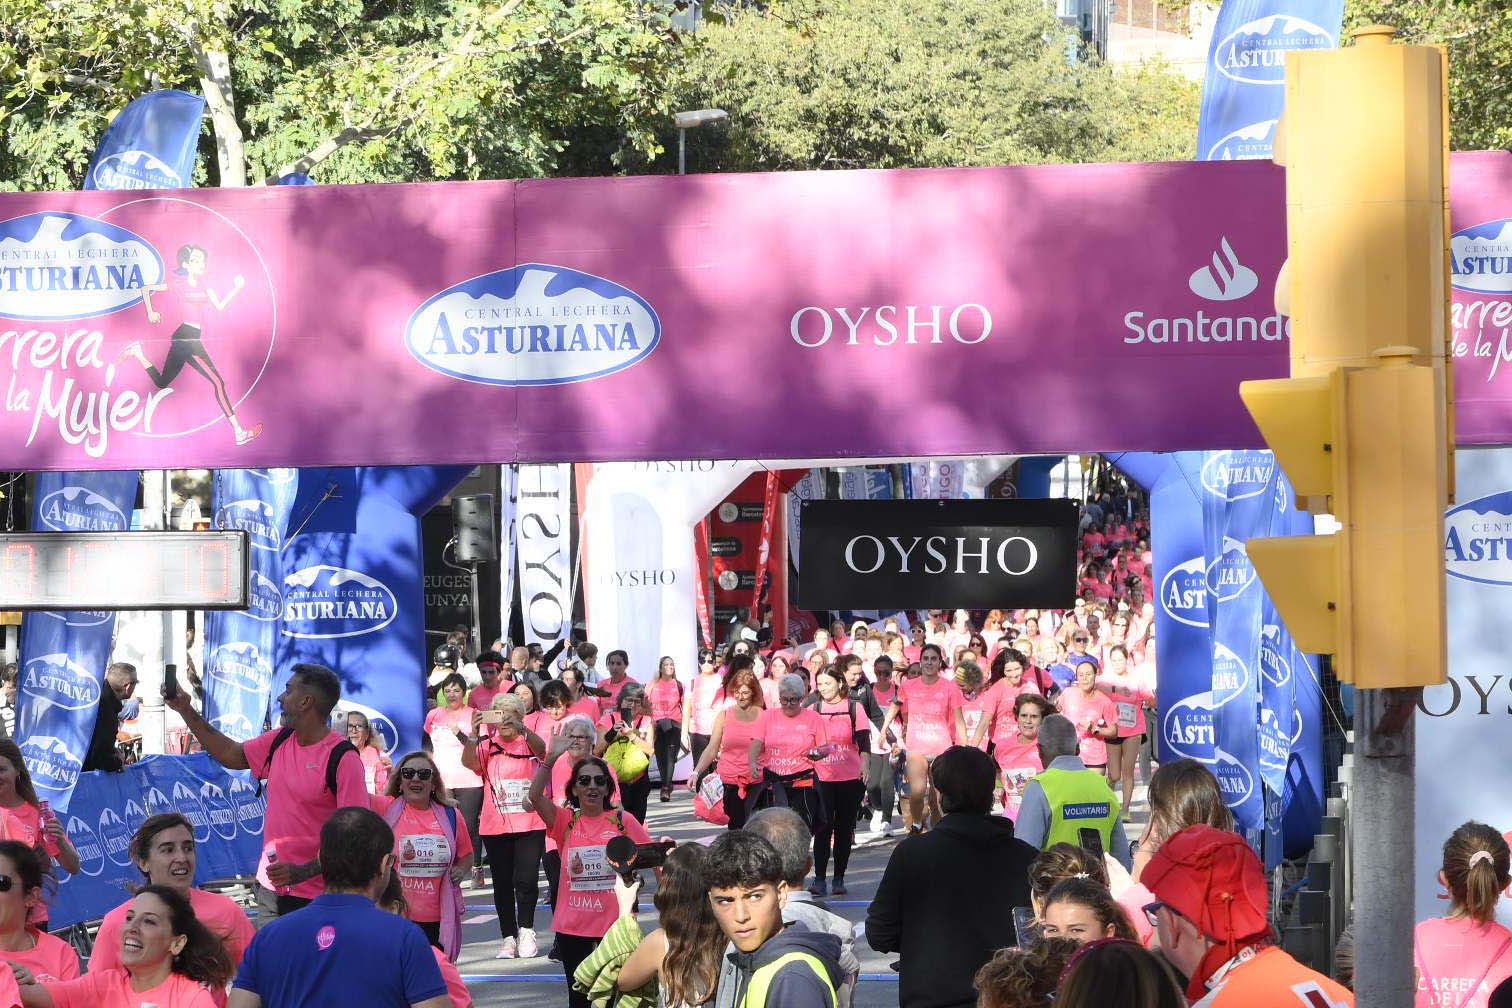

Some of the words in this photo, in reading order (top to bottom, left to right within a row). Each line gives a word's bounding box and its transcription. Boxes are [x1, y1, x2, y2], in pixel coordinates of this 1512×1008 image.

[1224, 43, 1286, 69] ASTUR
[68, 248, 138, 261] LECHERA
[464, 306, 544, 320] CENTRAL
[551, 303, 633, 318] LECHERA
[426, 311, 642, 356] ASTURIANA
[790, 302, 994, 348] OYSHO
[1123, 311, 1292, 345] Santand
[1474, 329, 1492, 357] la
[6, 374, 31, 412] la
[26, 362, 174, 458] Mujer
[1471, 523, 1512, 533] CENT
[521, 463, 565, 641] OYSH
[844, 533, 1039, 576] OYSHO
[599, 568, 677, 588] OYSHO
[333, 590, 383, 599] LECHERA
[283, 603, 388, 622] STURIANA
[1064, 806, 1108, 816] VOLUNTARIS
[416, 849, 434, 858] 016
[584, 862, 602, 871] 016
[568, 895, 603, 909] SUMA
